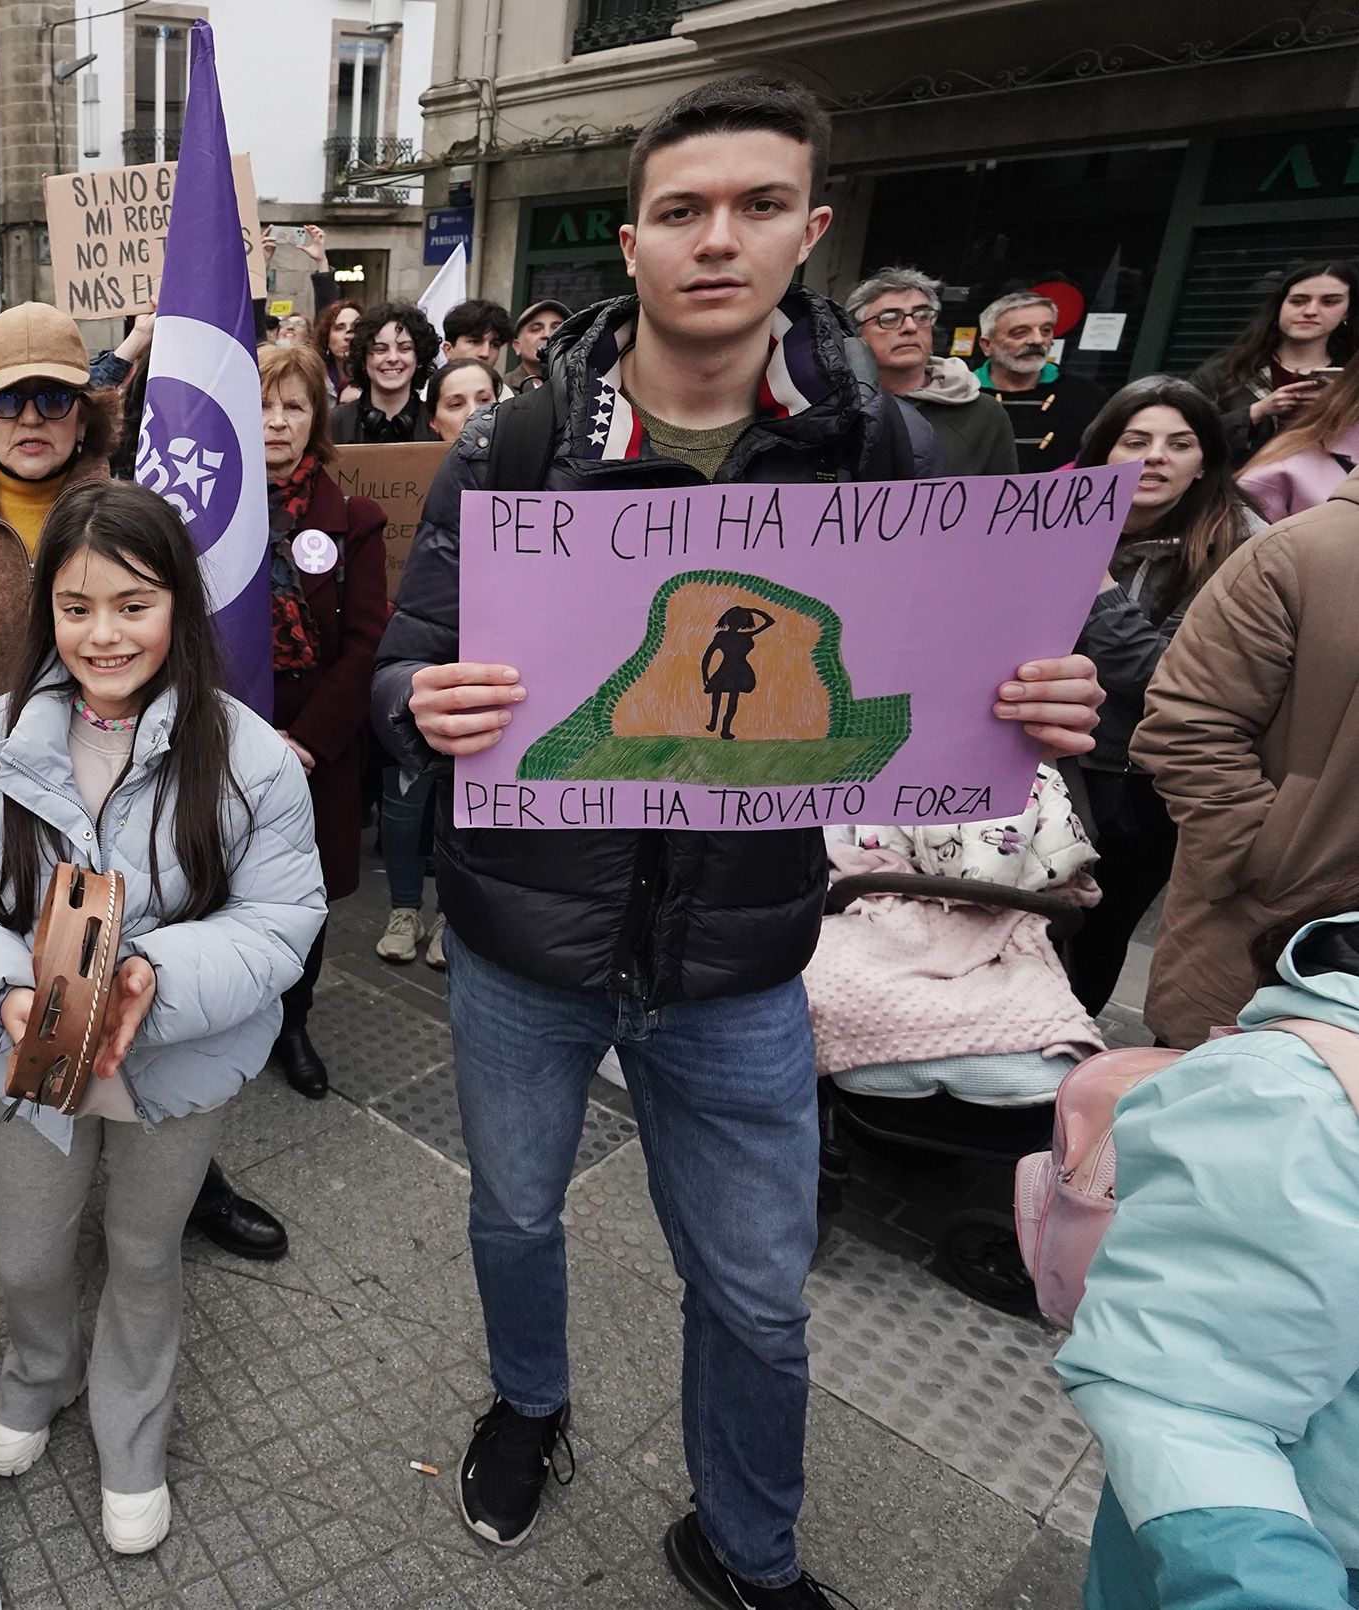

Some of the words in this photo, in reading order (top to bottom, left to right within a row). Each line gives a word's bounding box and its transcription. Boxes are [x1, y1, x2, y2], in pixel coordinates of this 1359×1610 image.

[1259, 138, 1359, 191] A
[109, 170, 148, 205] NO
[154, 167, 178, 201] E
[85, 200, 113, 238] MI
[551, 207, 630, 243] AR
[76, 241, 108, 271] NO
[119, 238, 150, 267] ME
[68, 271, 126, 314] MÁS
[491, 494, 572, 558] PER
[611, 496, 691, 560] CHI
[716, 487, 784, 550] HA
[810, 481, 967, 547] AVUTO
[986, 474, 1119, 536] PAURA
[465, 781, 545, 828] PER
[559, 786, 615, 826] CHI
[643, 788, 690, 826] HA
[707, 784, 866, 827] TROVATO
[892, 784, 992, 818] FORZA
